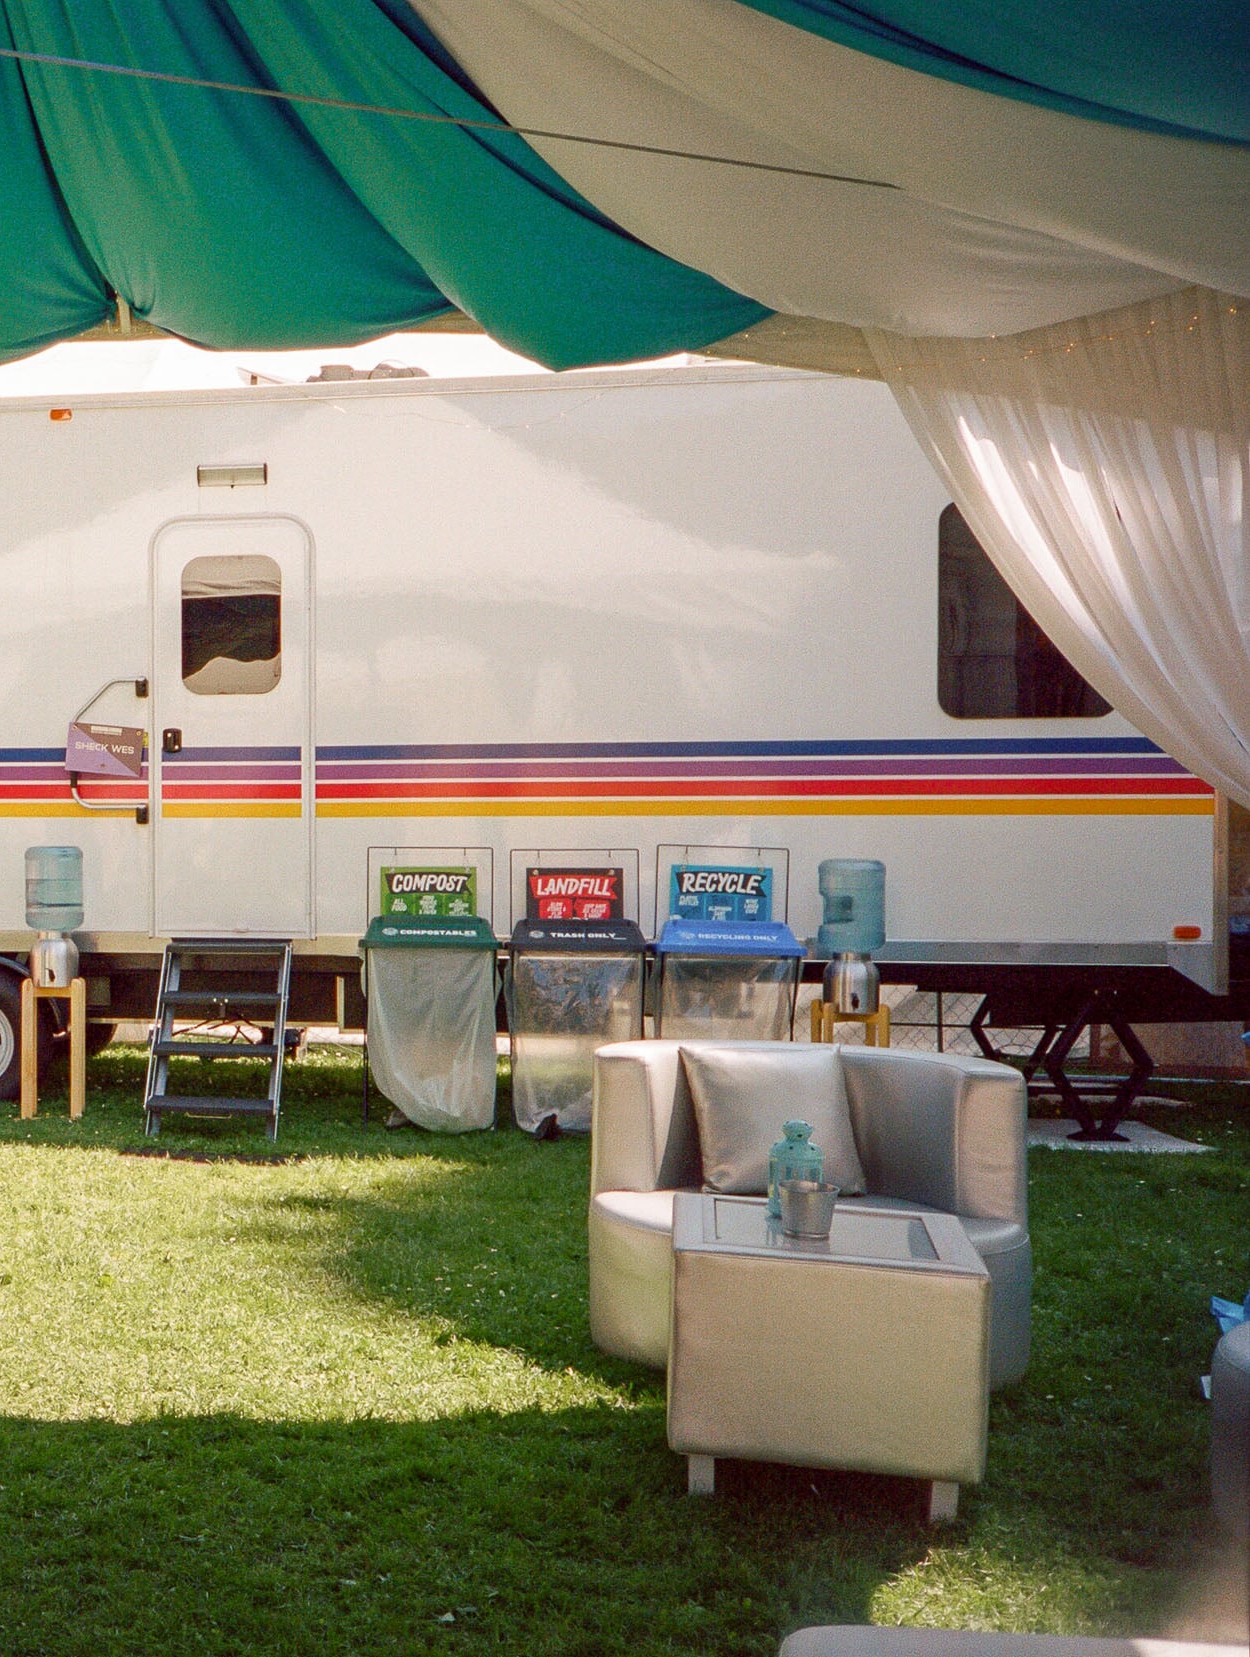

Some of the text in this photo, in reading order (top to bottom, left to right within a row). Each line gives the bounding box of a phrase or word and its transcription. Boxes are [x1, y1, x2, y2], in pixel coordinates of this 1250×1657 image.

[75, 741, 135, 755] SHECK WES
[391, 874, 468, 893] COMPOST
[536, 877, 611, 896] LANDFILL
[681, 872, 762, 895] RECYCLE
[399, 929, 477, 937] COMPOSTABLES
[697, 933, 751, 941] RECYCLING
